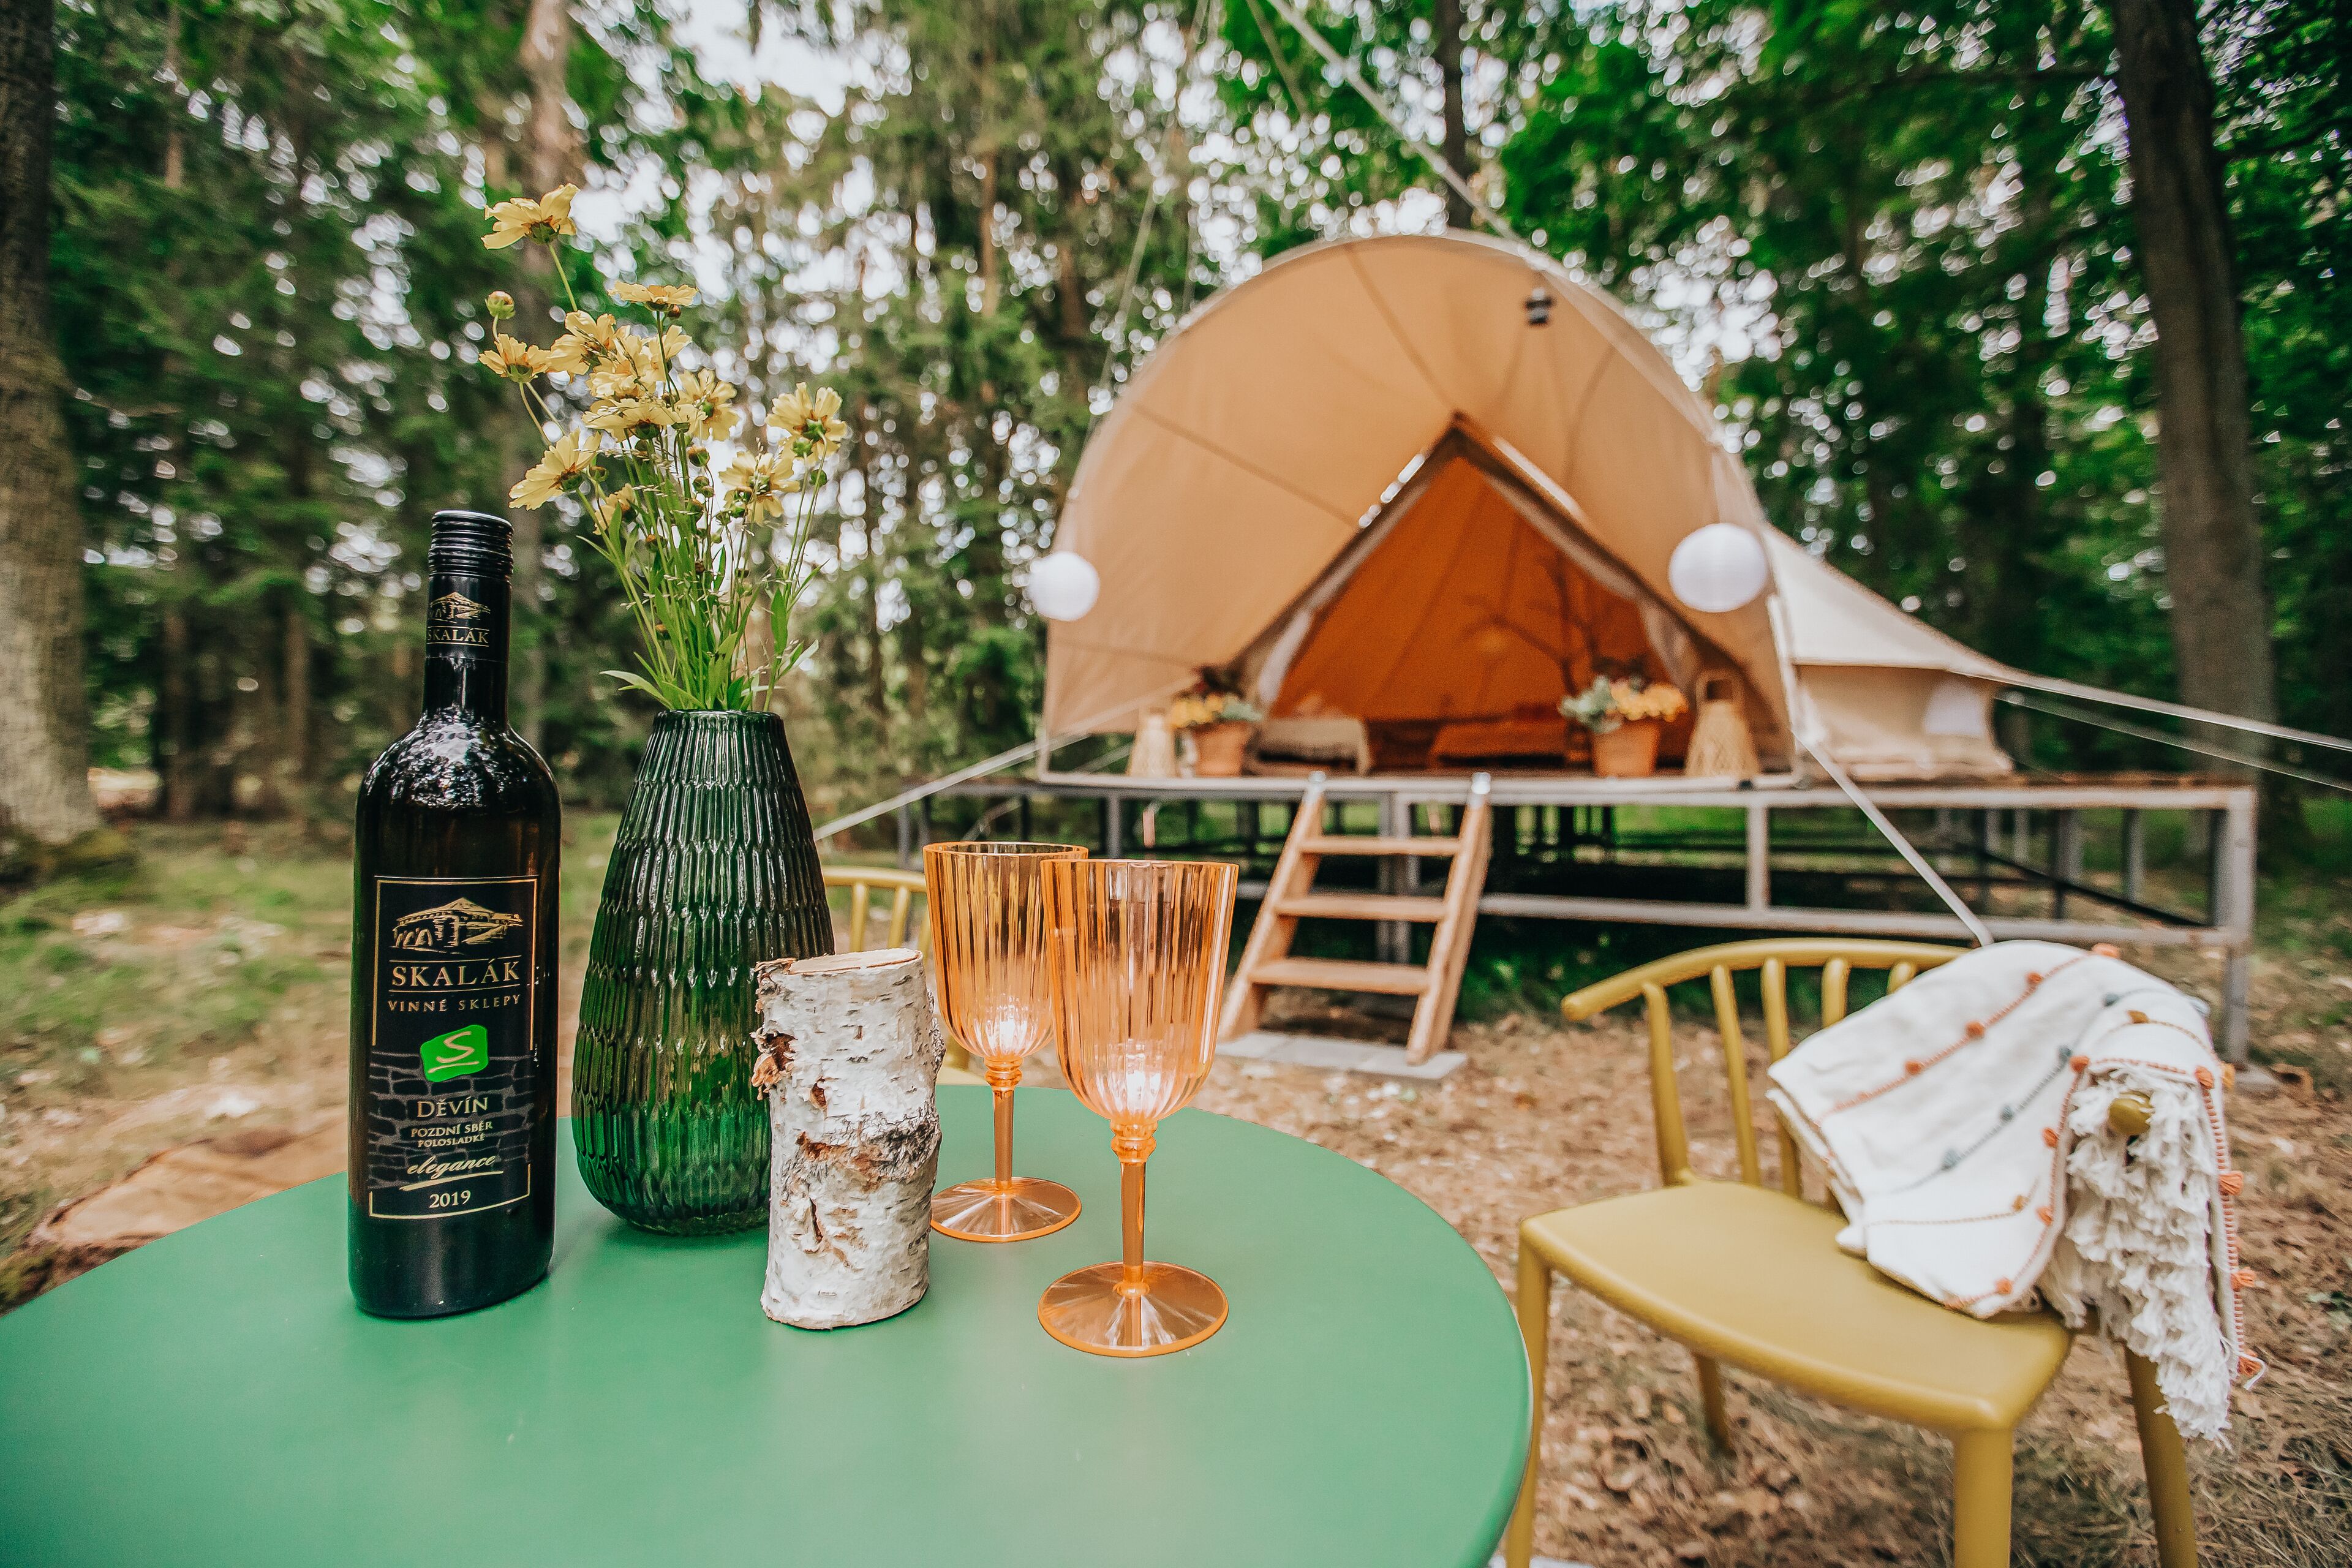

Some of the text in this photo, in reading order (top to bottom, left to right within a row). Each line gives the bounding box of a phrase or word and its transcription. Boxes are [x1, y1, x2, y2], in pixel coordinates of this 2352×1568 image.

[392, 958, 520, 987] SKALÁK
[388, 993, 521, 1012] VINNÉ SKLEPY
[417, 1096, 488, 1118] DĚVÍN
[411, 1123, 461, 1137] POZDNÍ
[417, 1133, 486, 1148] POLOSLADKÉ
[407, 1155, 496, 1180] elegance
[429, 1189, 471, 1208] 2019
